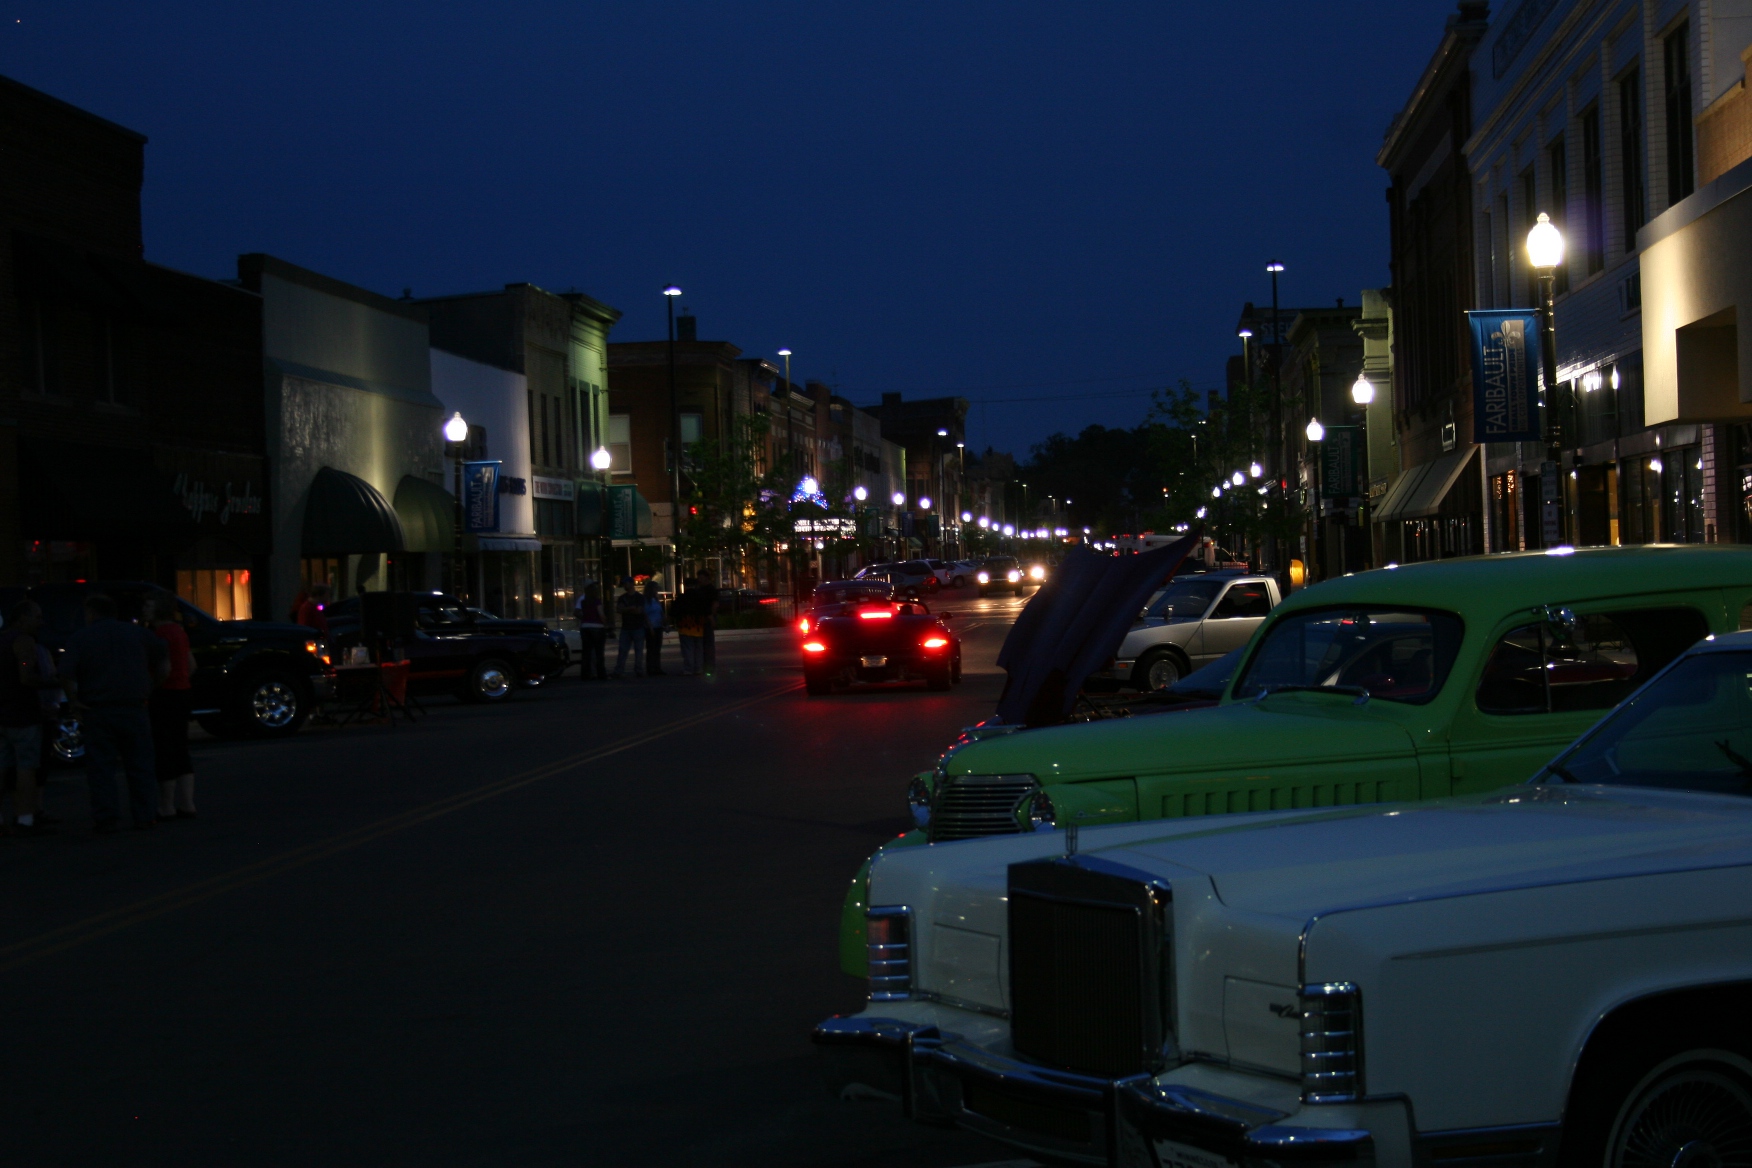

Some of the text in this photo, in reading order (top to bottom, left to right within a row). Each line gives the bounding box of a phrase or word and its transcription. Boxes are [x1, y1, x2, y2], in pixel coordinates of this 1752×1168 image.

[1483, 345, 1507, 434] FARIBAULT
[1517, 347, 1525, 399] OPPORTUNITIES
[1328, 446, 1340, 494] FARIBAULT
[470, 481, 482, 528] FARIBAULT
[614, 500, 624, 536] FARIBAULT
